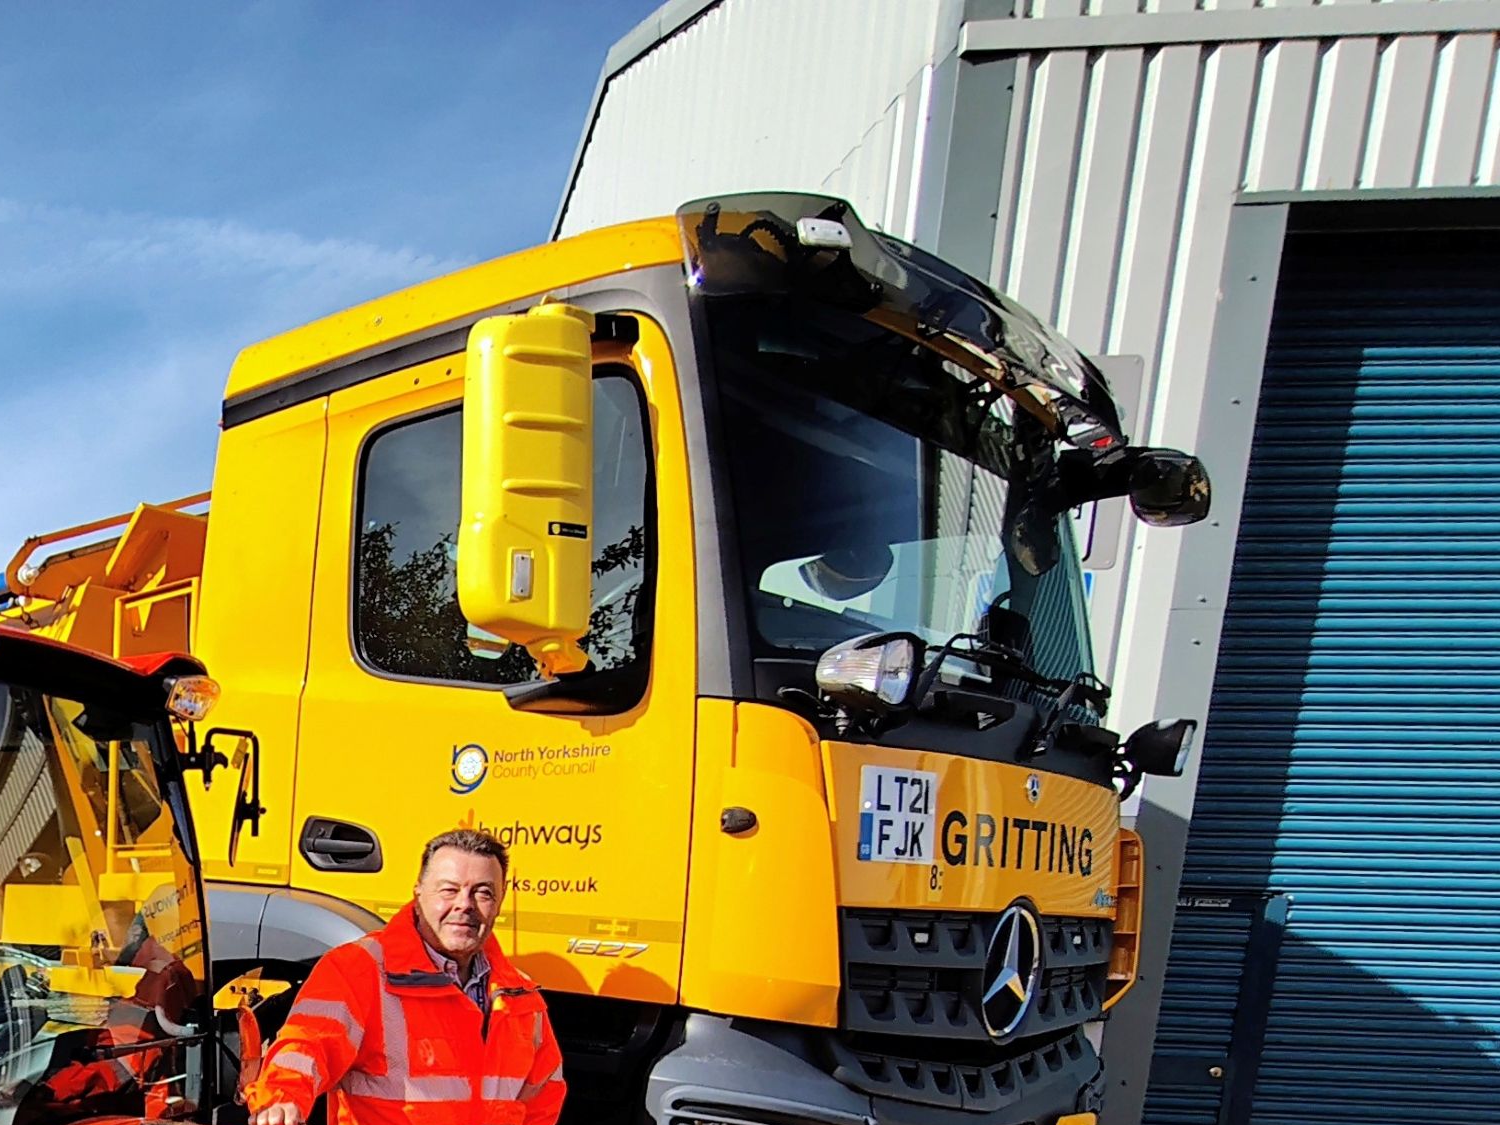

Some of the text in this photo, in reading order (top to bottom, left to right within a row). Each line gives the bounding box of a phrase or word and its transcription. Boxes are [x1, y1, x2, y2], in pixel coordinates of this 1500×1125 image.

[494, 743, 611, 764] North Yorkshire
[492, 760, 596, 780] County Council
[877, 819, 925, 858] FJK
[941, 809, 1093, 877] GRITTING
[566, 936, 650, 959] 1827
